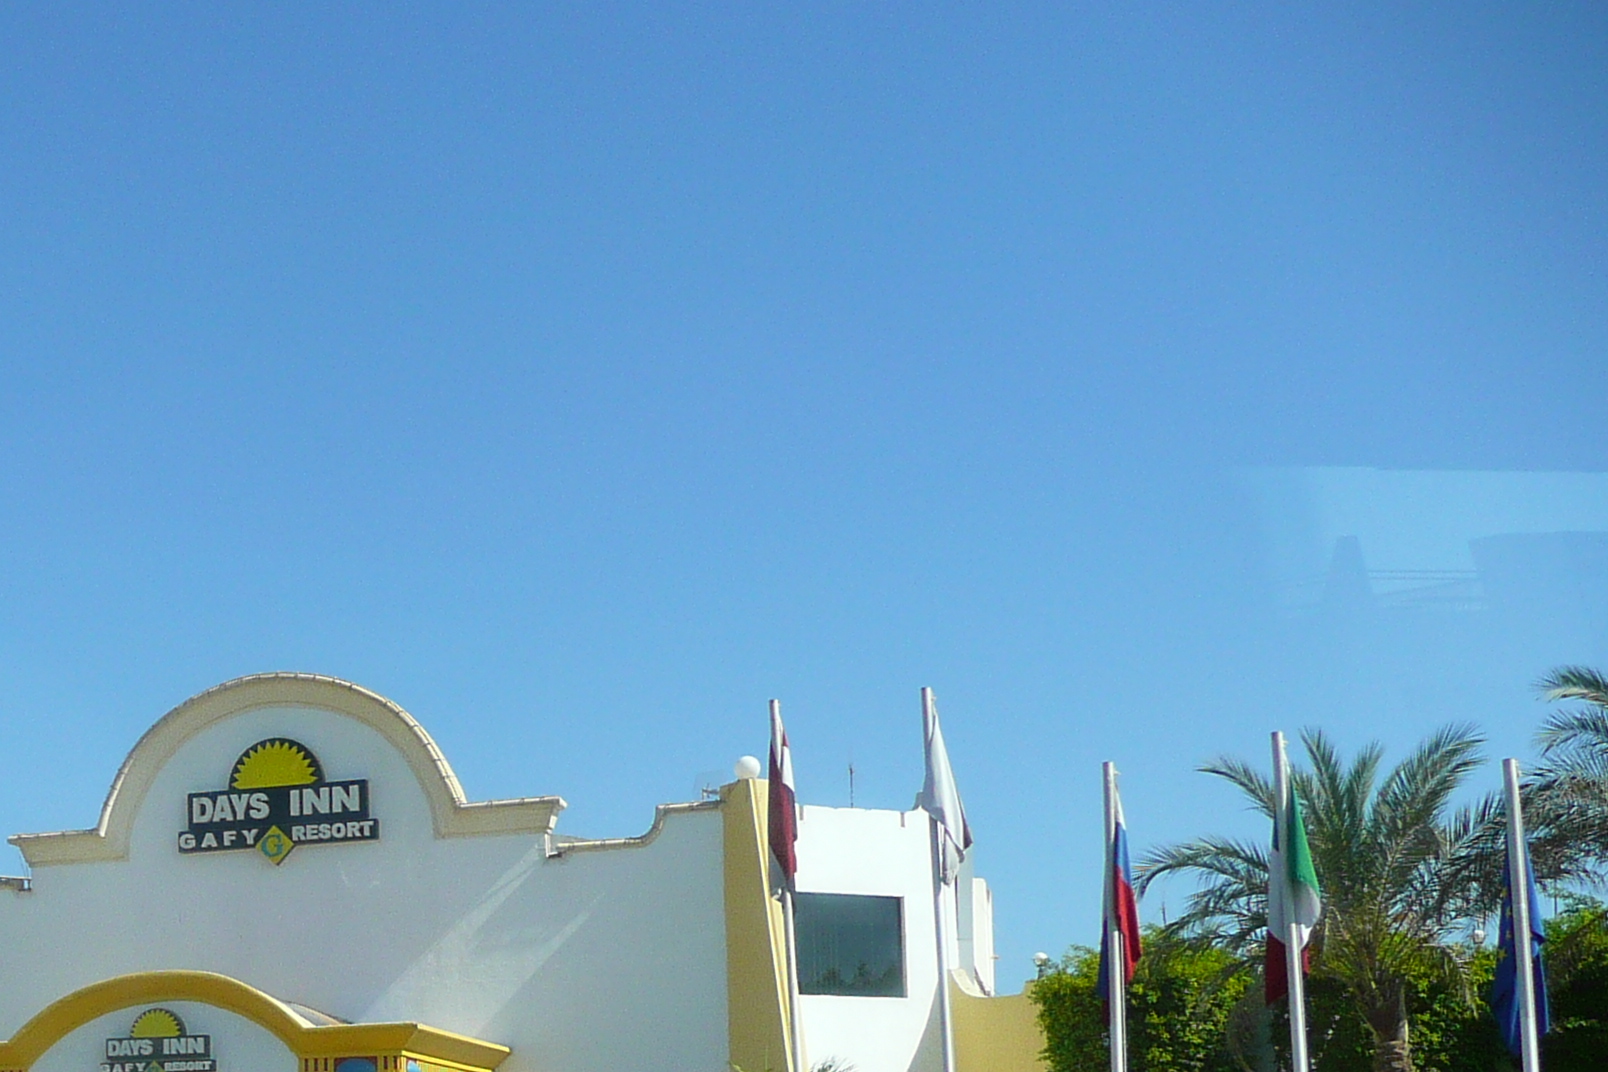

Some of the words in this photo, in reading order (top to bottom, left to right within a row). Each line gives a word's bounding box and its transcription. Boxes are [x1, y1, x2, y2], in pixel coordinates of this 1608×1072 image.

[192, 793, 270, 824] DAYS
[290, 785, 360, 816] INN
[179, 829, 258, 850] GAFY
[292, 821, 374, 841] RESORT
[261, 834, 284, 858] G
[107, 1039, 154, 1057] DAYS
[163, 1037, 205, 1055] INN
[164, 1061, 212, 1071] RESORT
